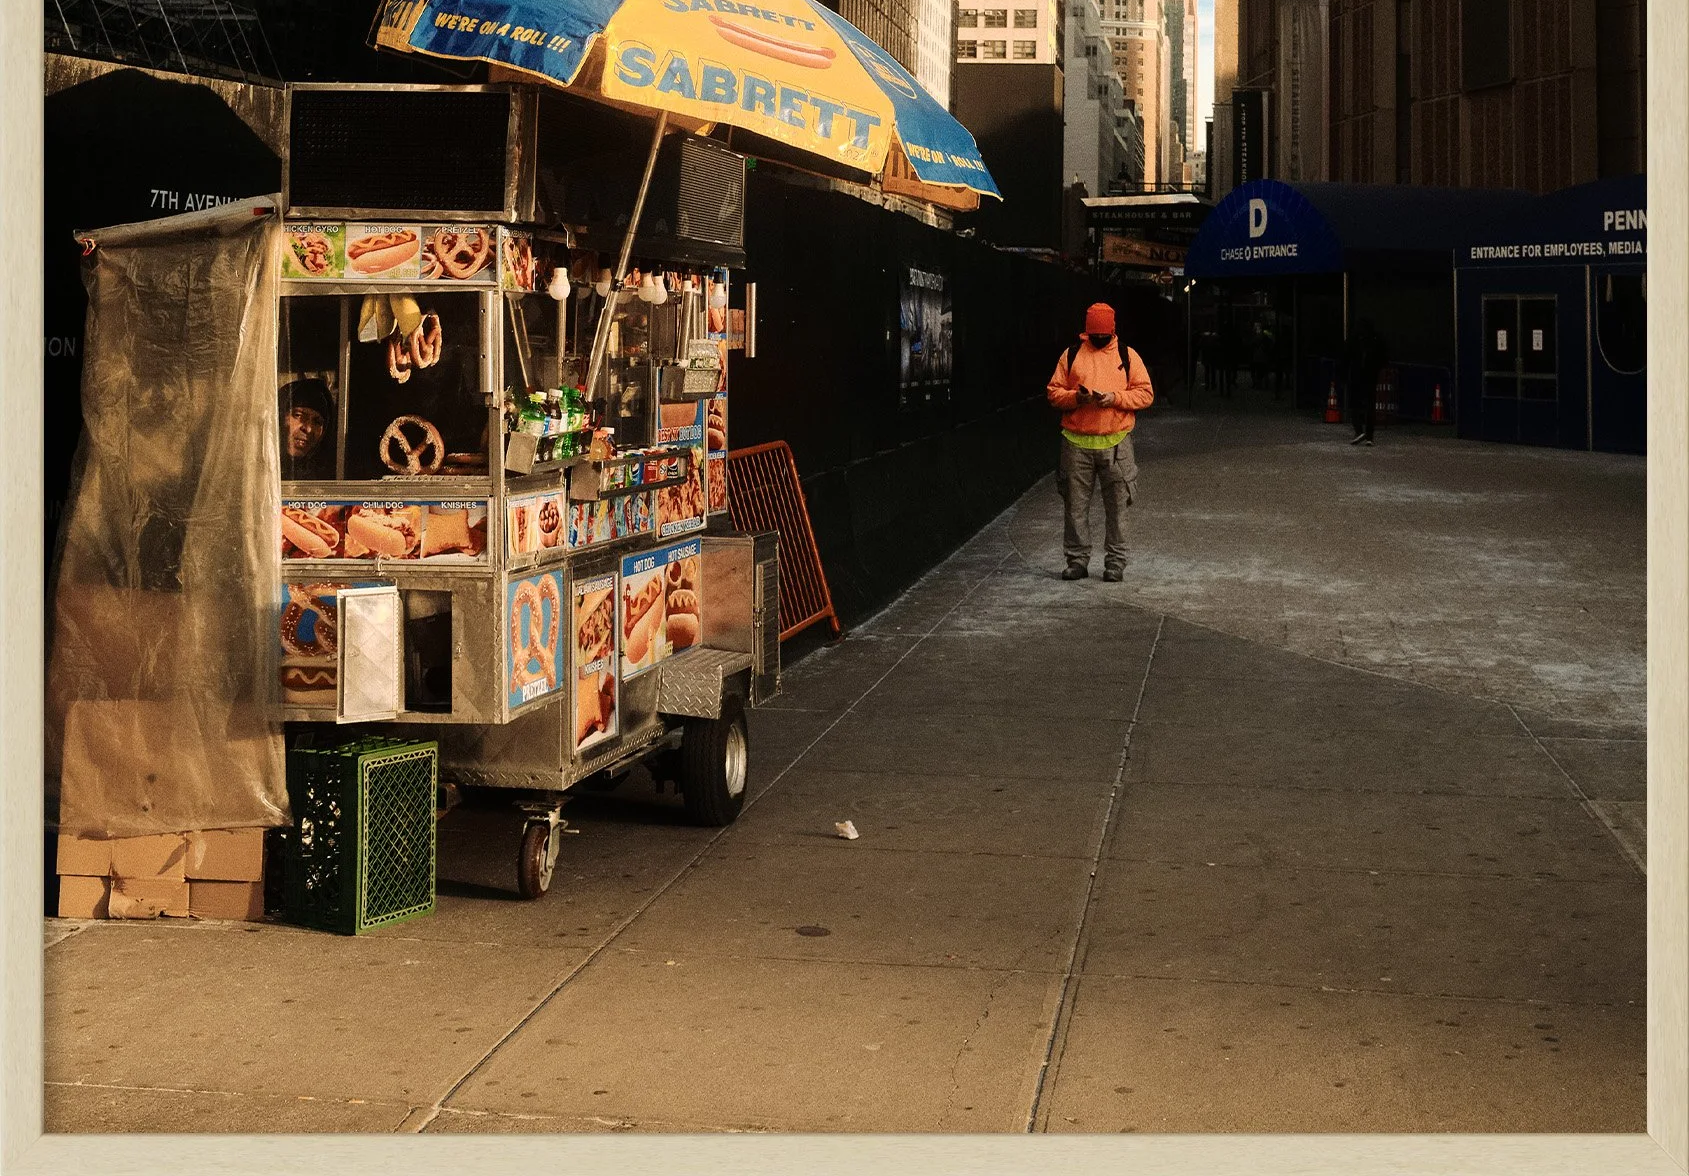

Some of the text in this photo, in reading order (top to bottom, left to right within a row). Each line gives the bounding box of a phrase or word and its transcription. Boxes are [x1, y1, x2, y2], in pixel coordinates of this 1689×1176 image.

[434, 12, 479, 33] WE'RE
[496, 23, 511, 36] A
[509, 26, 547, 46] ROLL
[614, 40, 881, 151] SABRETT
[150, 189, 240, 212] 7TH AVEN
[1092, 211, 1156, 219] STEAKHOUSE
[1173, 211, 1193, 219] BAR
[1249, 198, 1268, 238] D
[1603, 209, 1648, 231] PENN
[282, 225, 339, 233] HICKEN GYRO
[365, 225, 403, 233] HOT DOG
[441, 226, 479, 234] PRETZEL
[1220, 244, 1298, 260] CHASE ENTRANCE
[1471, 245, 1520, 259] ENTRANCE
[1522, 244, 1542, 258] FOR
[1544, 242, 1606, 257] EMPLOYEES,
[1609, 240, 1643, 255] MEDIA
[441, 501, 477, 509] KNISHES
[667, 543, 697, 563] HOT SAUSAGE
[633, 556, 655, 573] HOT DOG
[522, 678, 549, 702] PRETZEL
